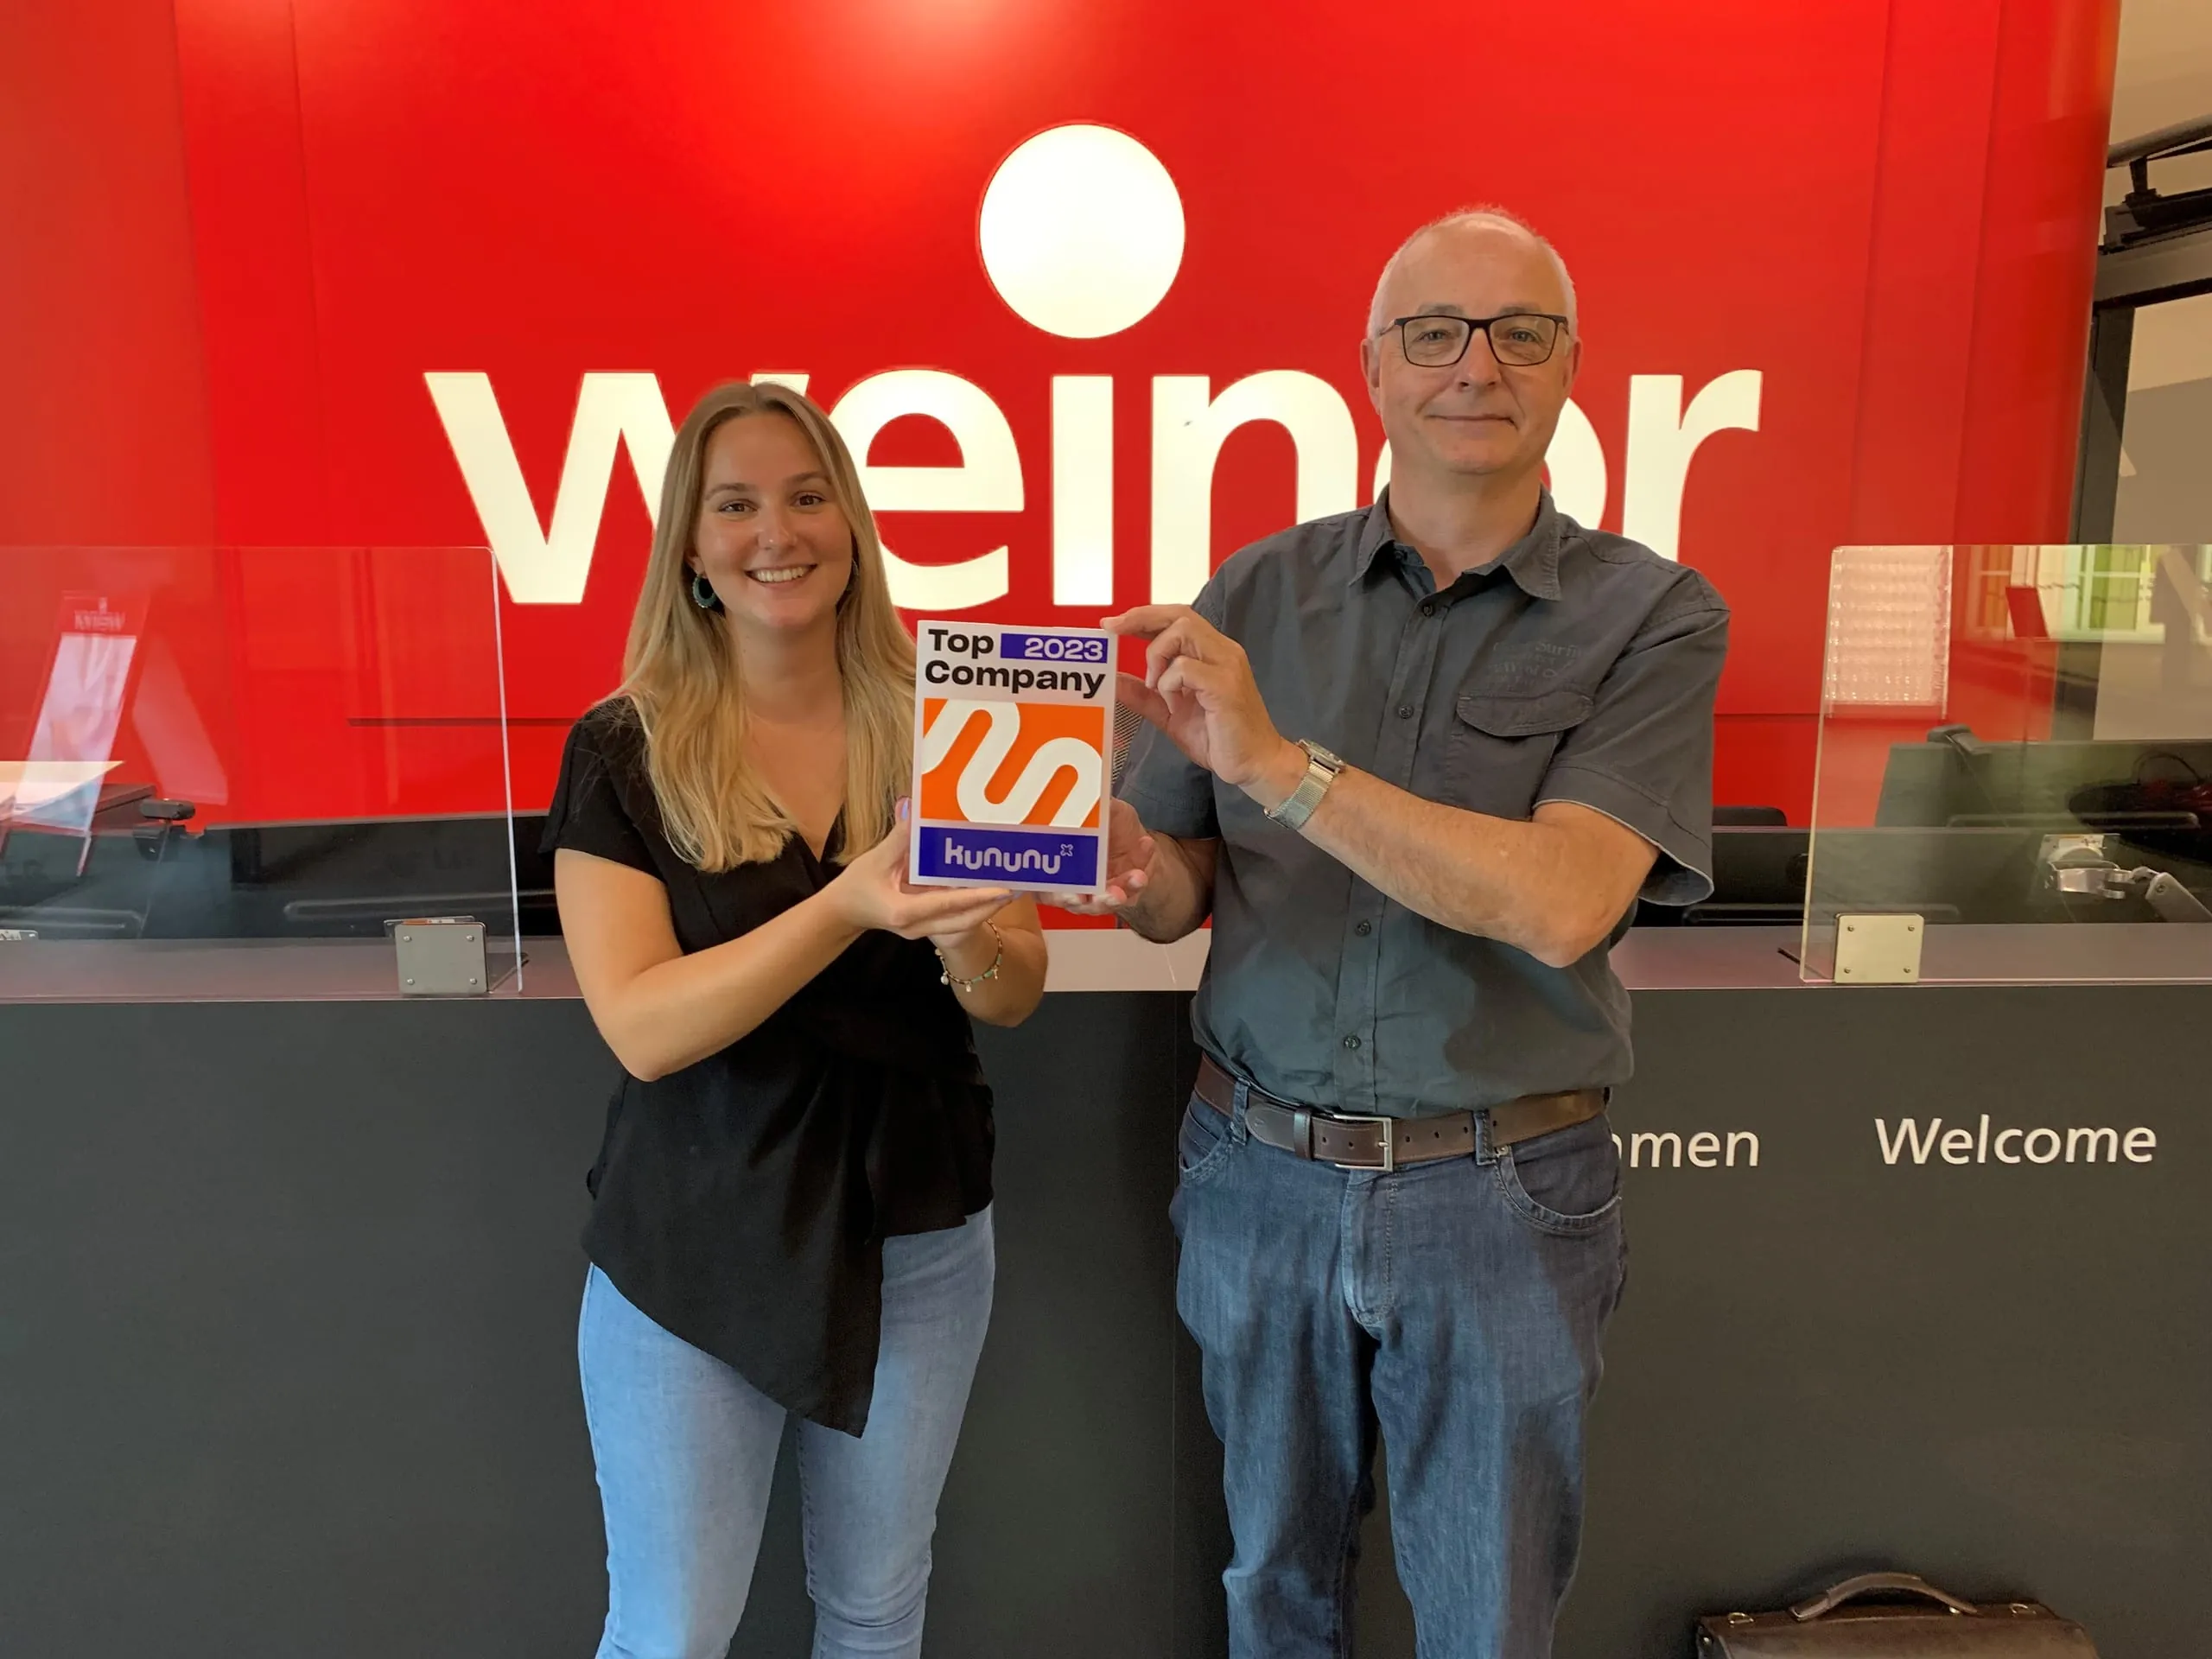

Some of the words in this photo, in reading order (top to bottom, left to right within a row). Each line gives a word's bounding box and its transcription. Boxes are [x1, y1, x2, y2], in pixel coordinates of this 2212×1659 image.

[424, 124, 1762, 610] weinr
[927, 628, 995, 660] Top
[1024, 637, 1104, 662] 2023
[925, 659, 1107, 699] Company
[944, 836, 1061, 874] kununu
[1611, 1130, 1759, 1168] men
[1874, 1114, 2157, 1165] Welcome
